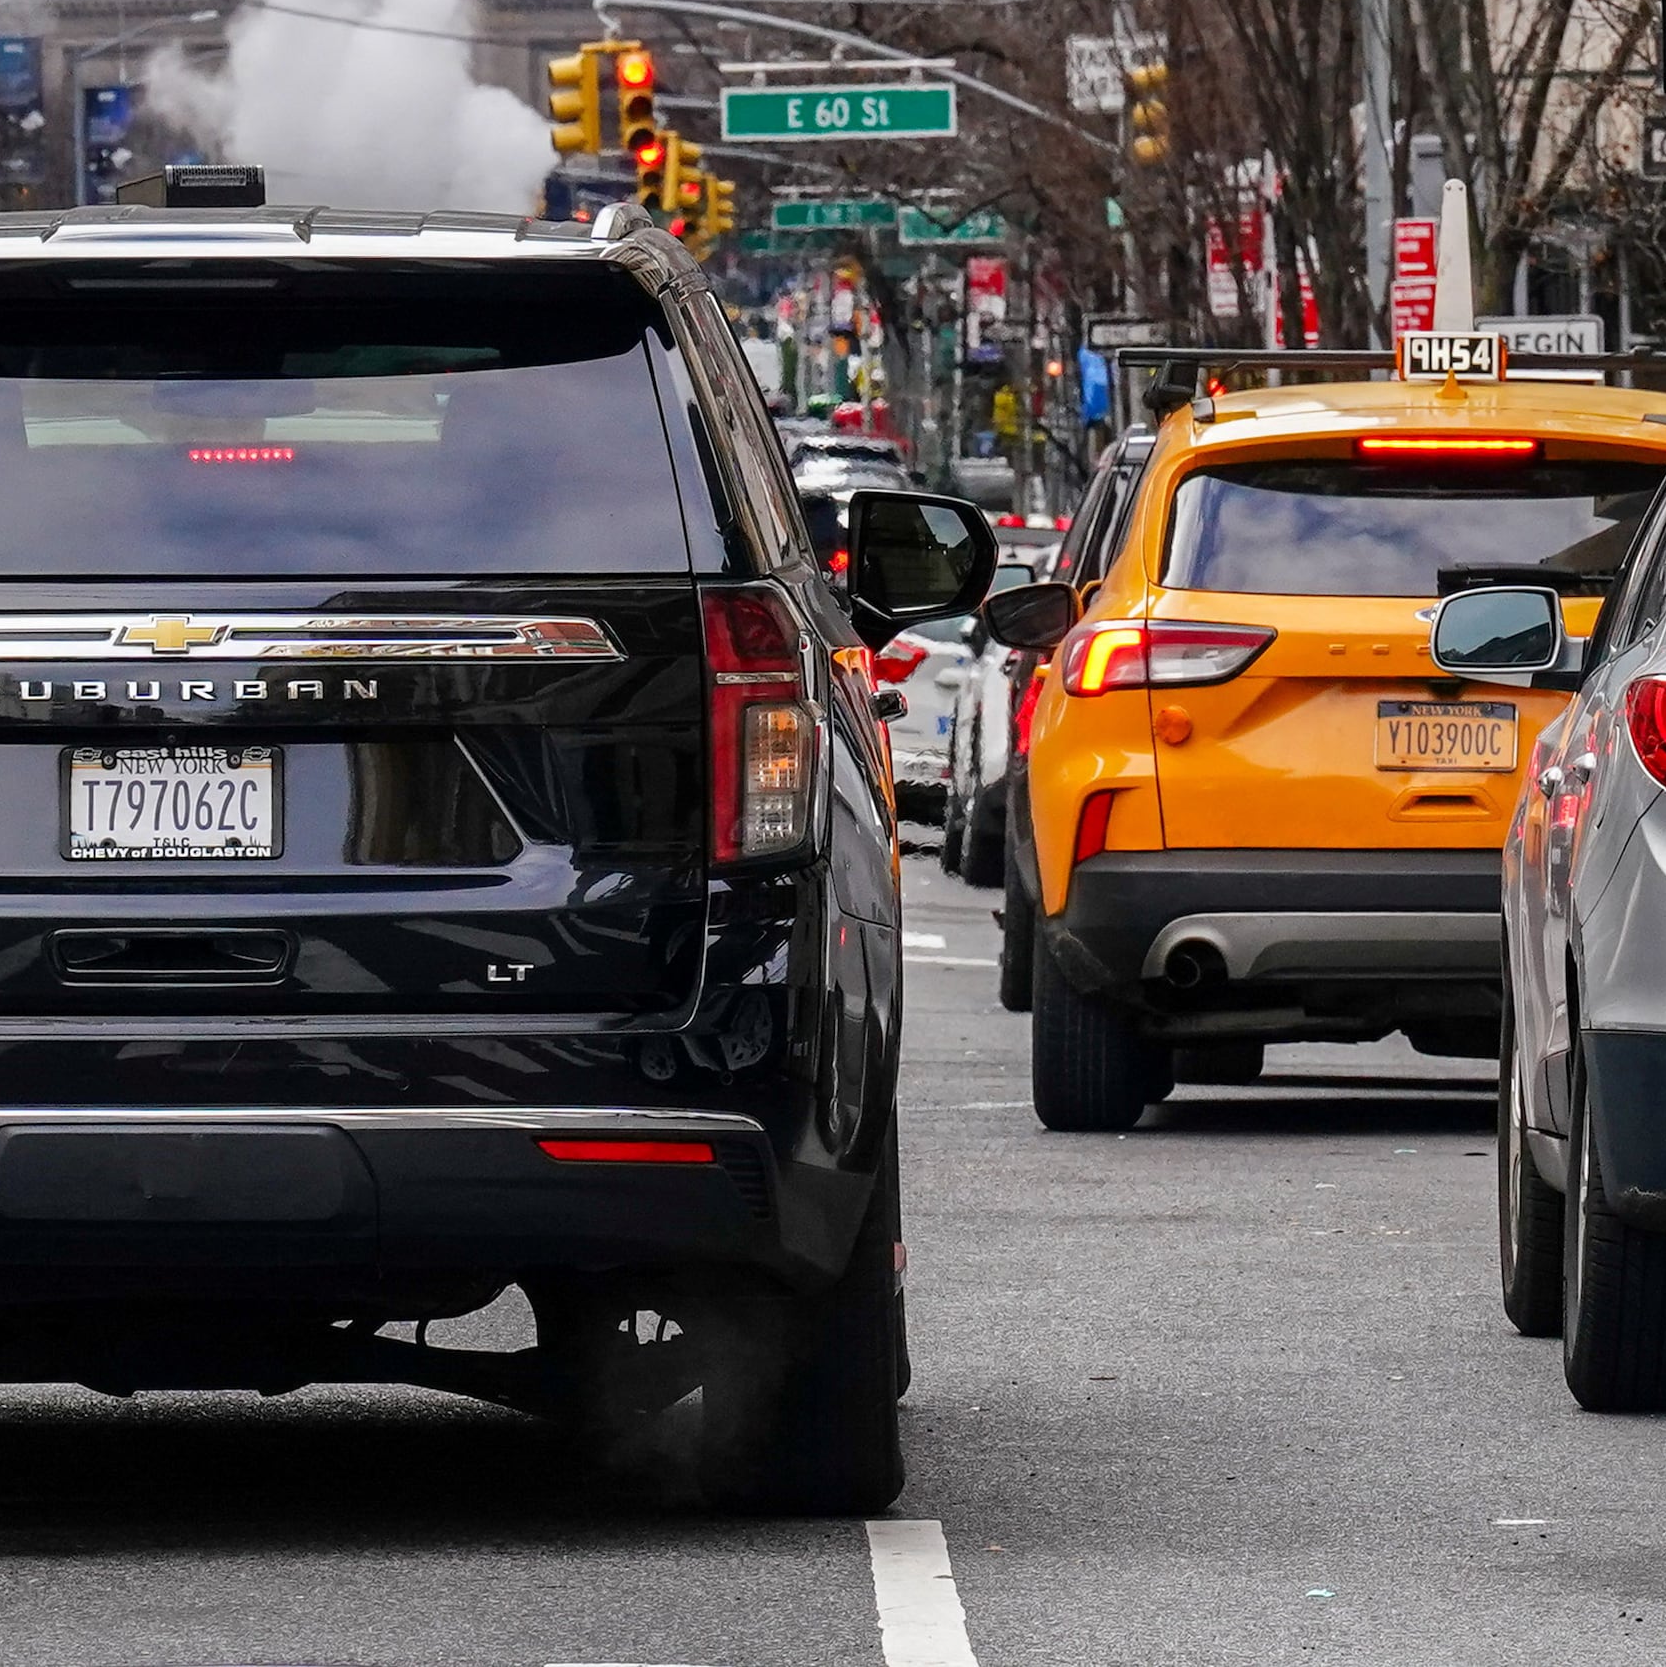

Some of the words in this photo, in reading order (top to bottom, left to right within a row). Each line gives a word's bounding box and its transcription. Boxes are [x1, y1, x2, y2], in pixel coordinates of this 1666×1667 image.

[787, 98, 804, 128] E
[815, 97, 850, 128] 60
[861, 96, 890, 126] St
[1410, 338, 1491, 371] 9H54
[1412, 705, 1445, 716] NEW
[1447, 705, 1482, 717] YORK
[1389, 721, 1502, 755] Y103900C
[116, 747, 169, 760] east
[175, 747, 228, 759] hills
[119, 759, 171, 774] NEW
[174, 759, 226, 774] YORK
[82, 780, 258, 831] T797062C
[71, 848, 128, 858] CHEVY
[131, 847, 147, 858] of
[152, 847, 271, 858] DOUGLASTON
[487, 964, 534, 981] LT
